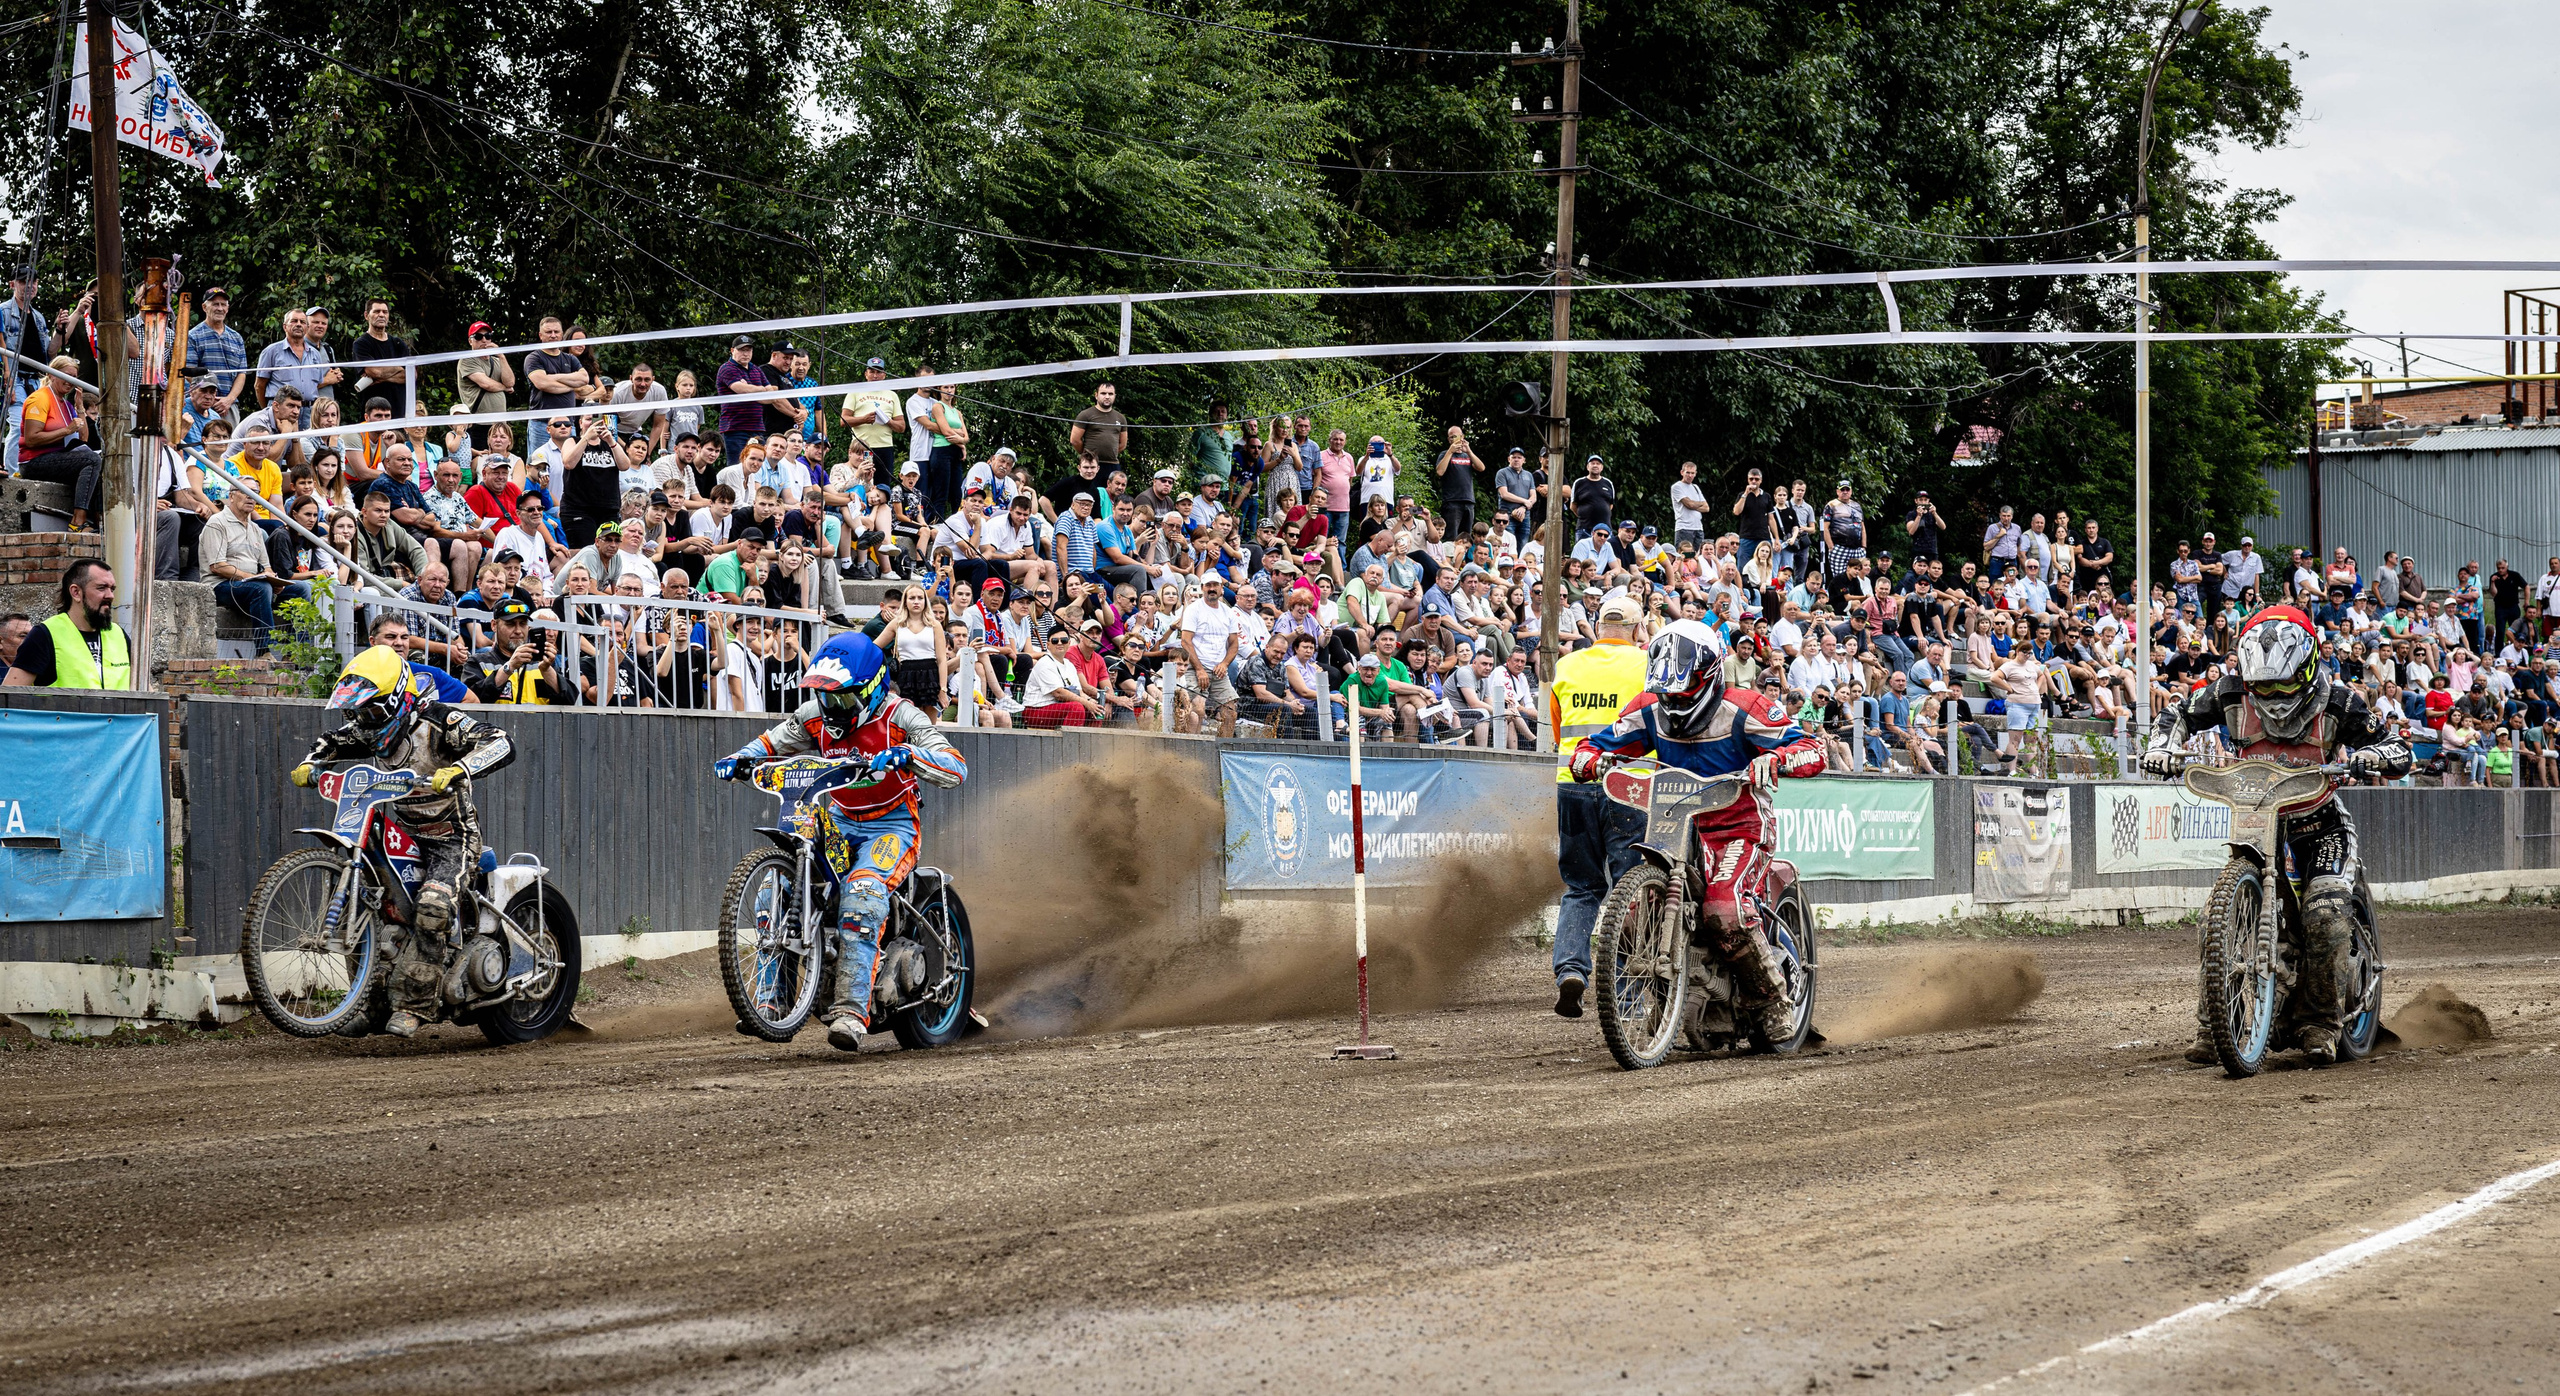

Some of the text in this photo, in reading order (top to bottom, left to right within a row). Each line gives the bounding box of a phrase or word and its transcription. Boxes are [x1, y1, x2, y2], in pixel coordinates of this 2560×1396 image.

[1572, 692, 1618, 709] СУДЬЯ
[784, 770, 816, 779] SPEEDWAY
[0, 800, 27, 834] А
[1326, 789, 1418, 821] ФЕЕРАЦИЯ
[1774, 803, 1857, 858] ТРИУМФ
[2144, 802, 2231, 842] АВТОИНЖЕН
